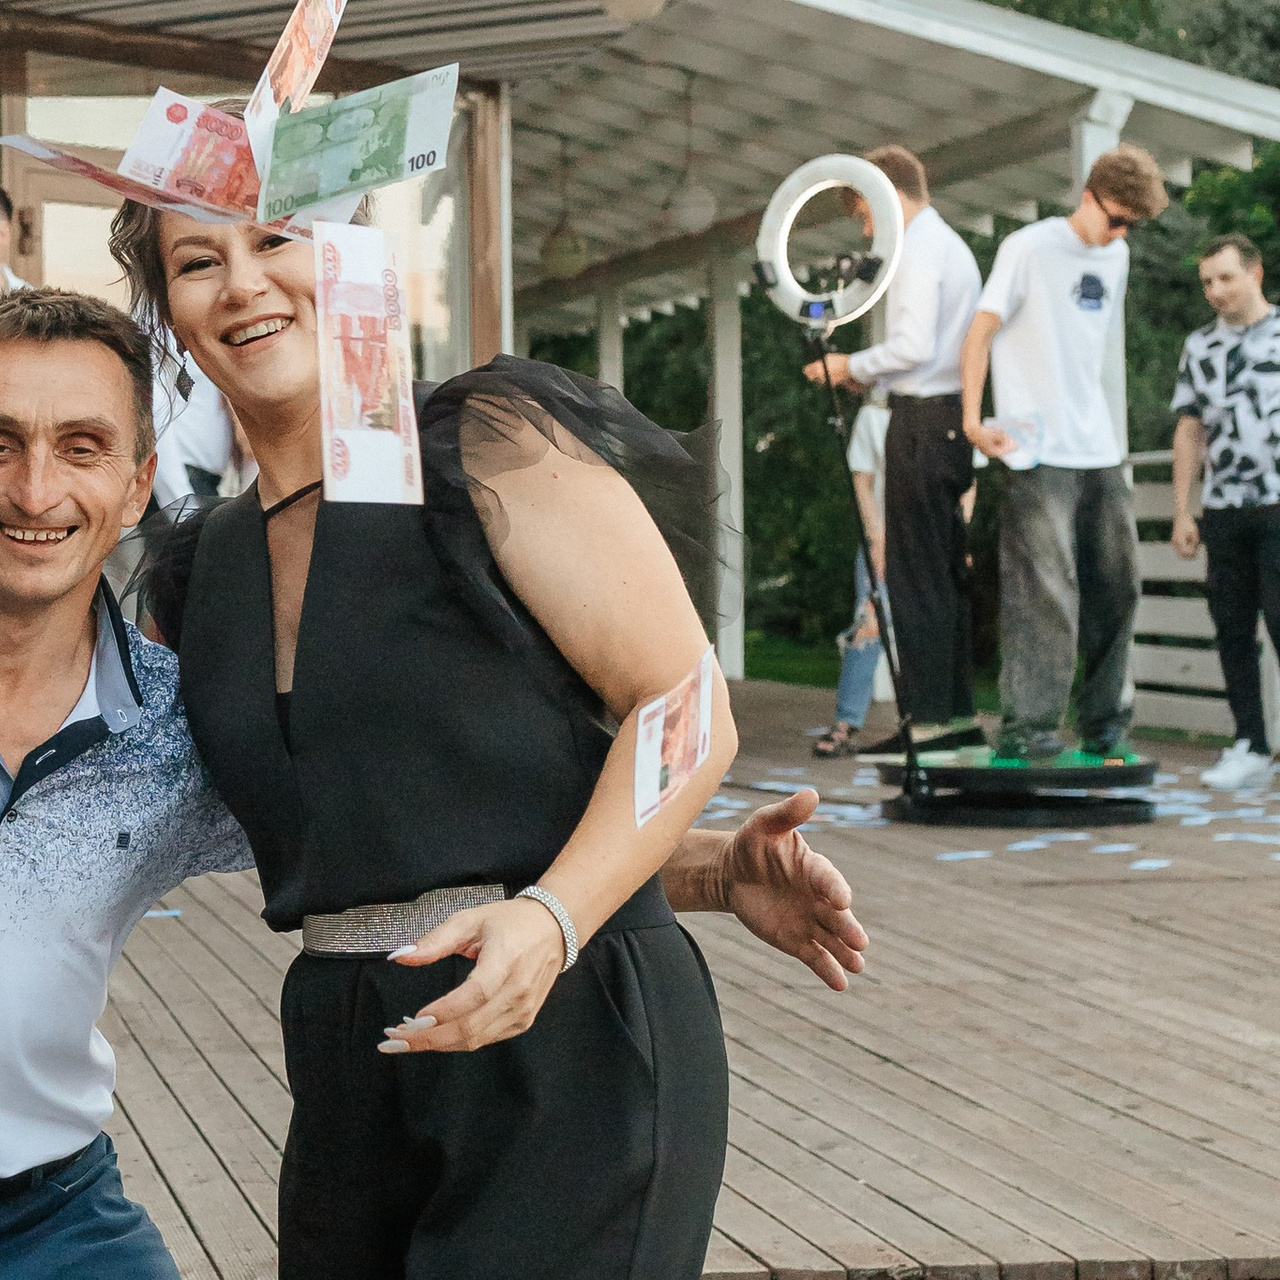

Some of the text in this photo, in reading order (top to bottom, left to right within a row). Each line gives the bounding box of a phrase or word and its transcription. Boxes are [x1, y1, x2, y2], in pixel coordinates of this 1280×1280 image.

[266, 150, 437, 218] 100 100
[381, 269, 402, 331] 5000
